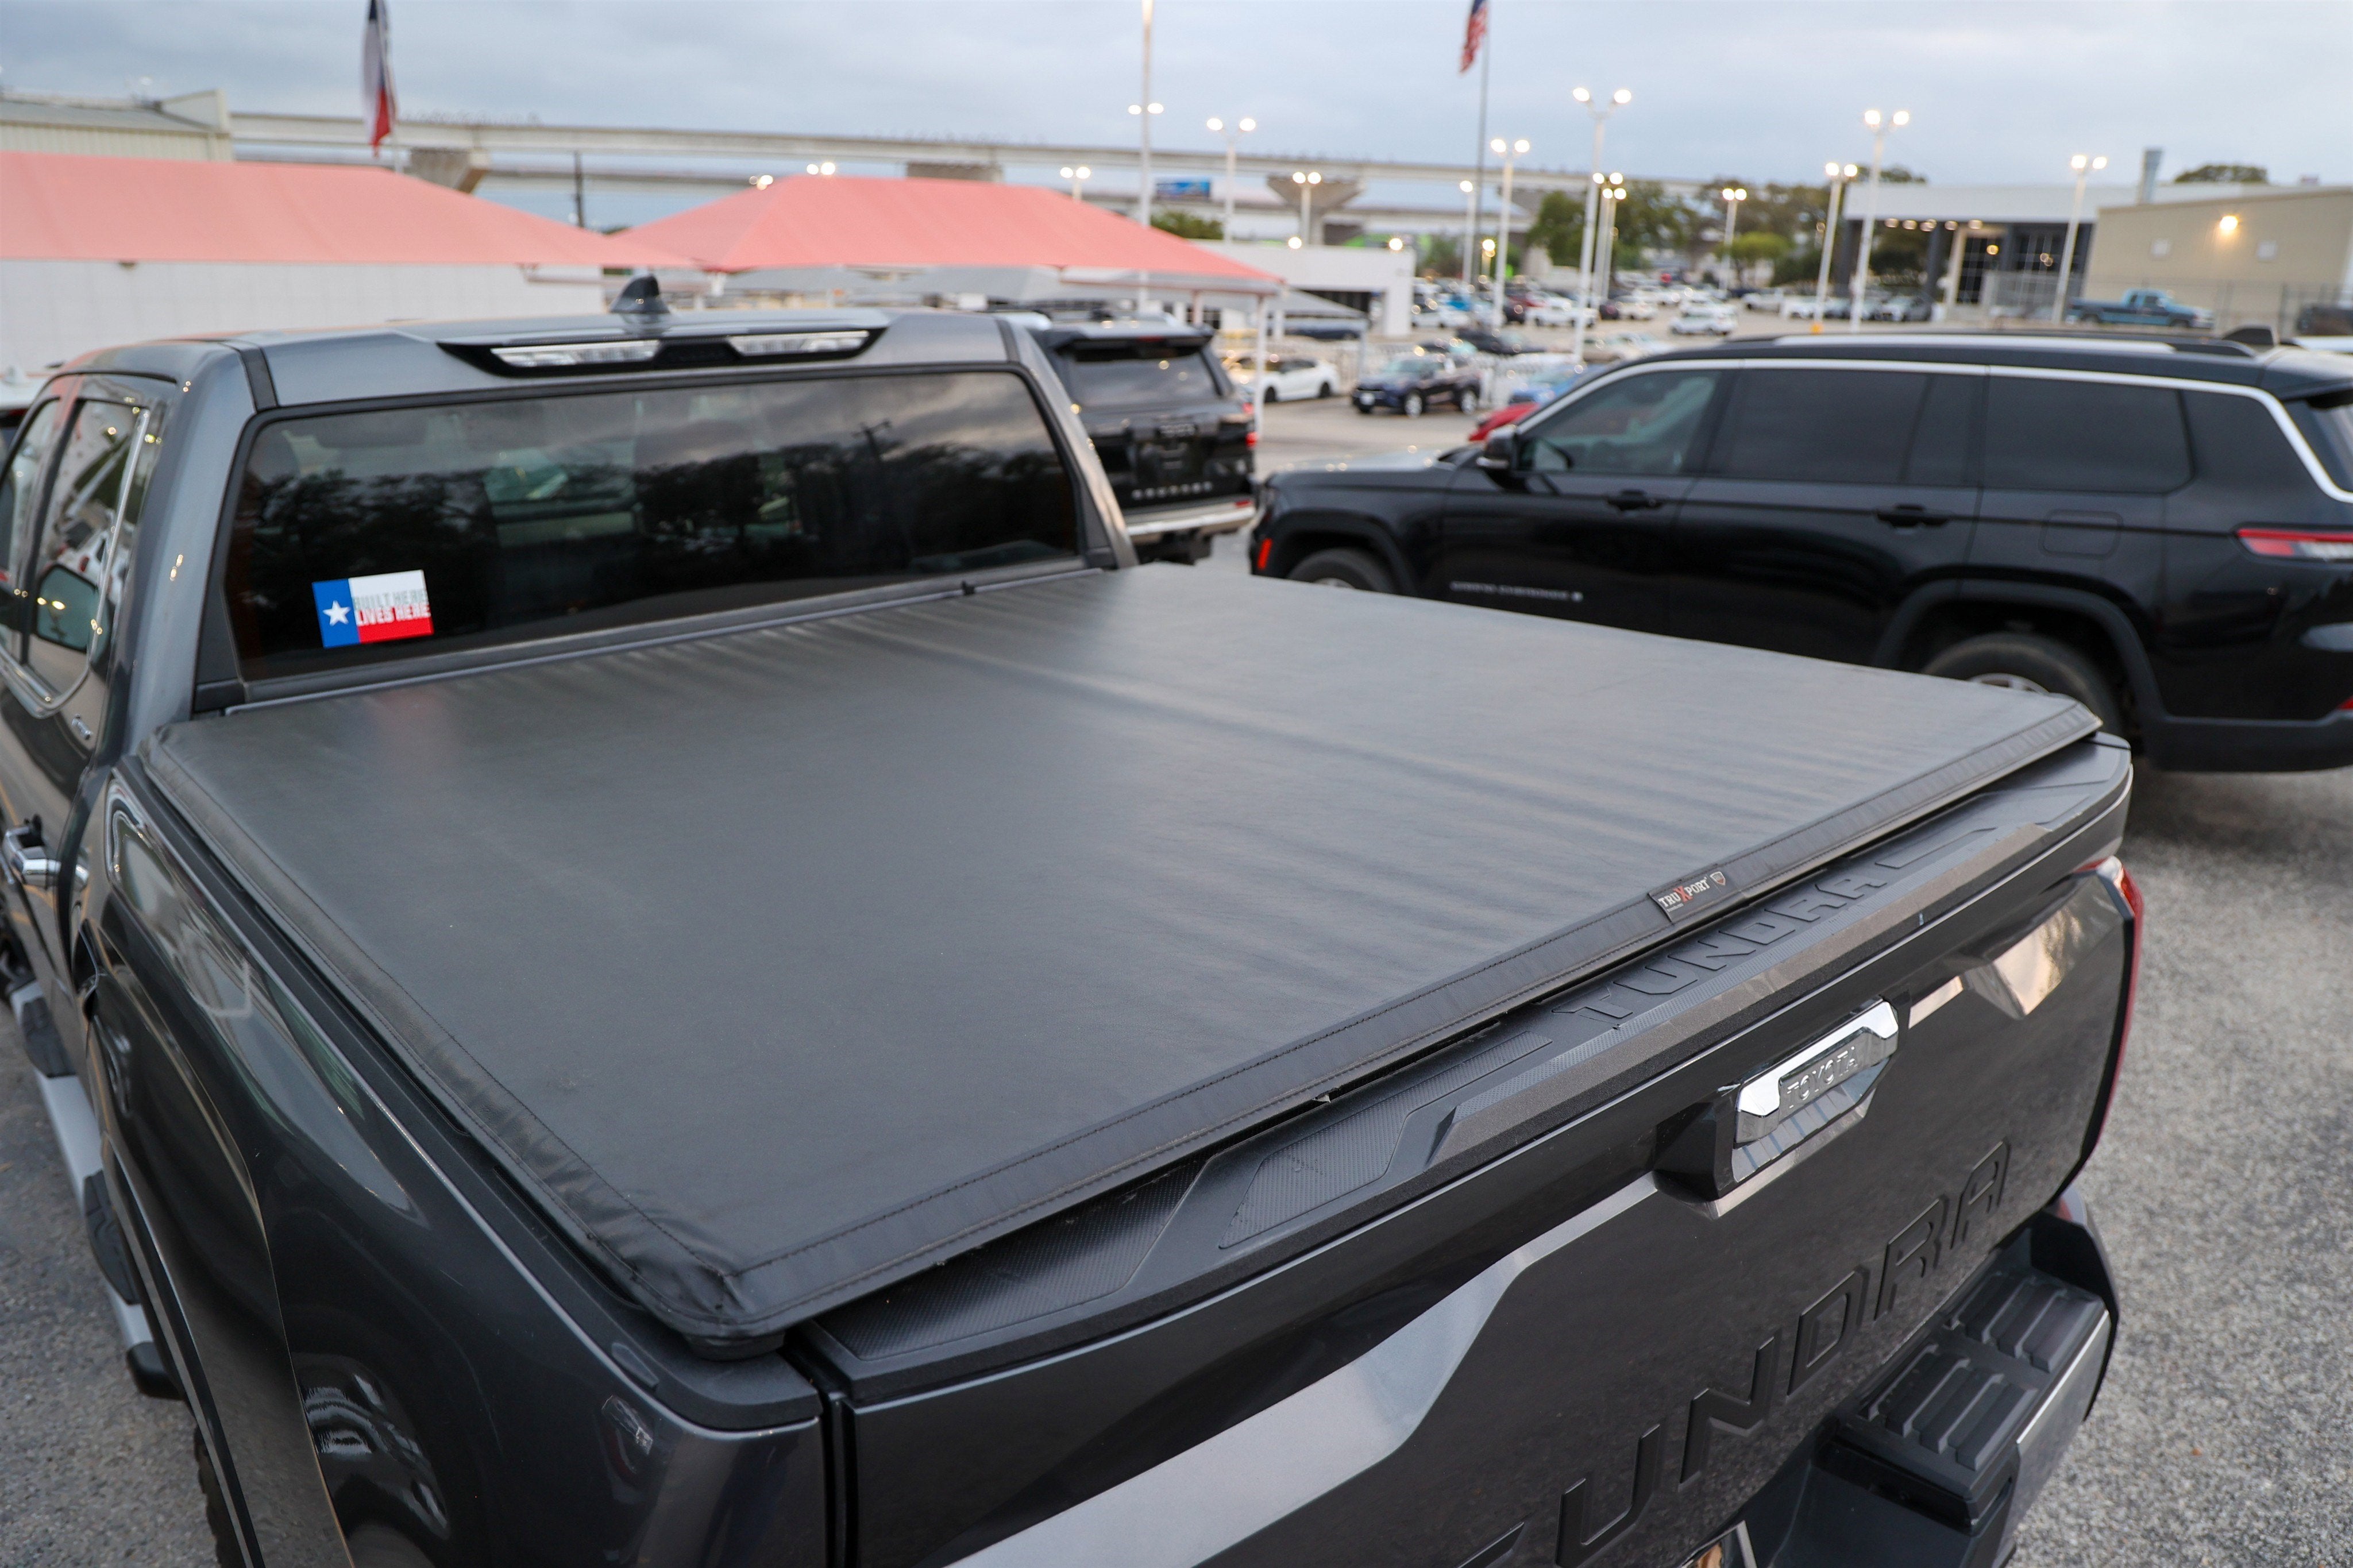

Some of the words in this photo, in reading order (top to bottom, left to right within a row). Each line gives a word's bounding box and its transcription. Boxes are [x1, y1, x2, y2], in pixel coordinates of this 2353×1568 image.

[353, 594, 390, 609] BUILT
[392, 588, 429, 605] HERE
[356, 607, 395, 625] LIVES
[395, 602, 431, 621] HERE
[1658, 879, 1710, 907] TRUXPORT
[1552, 878, 1888, 1019] TUNDRA
[1786, 1046, 1859, 1109] TOYOTA
[1457, 1140, 2010, 1568] UNDRA
